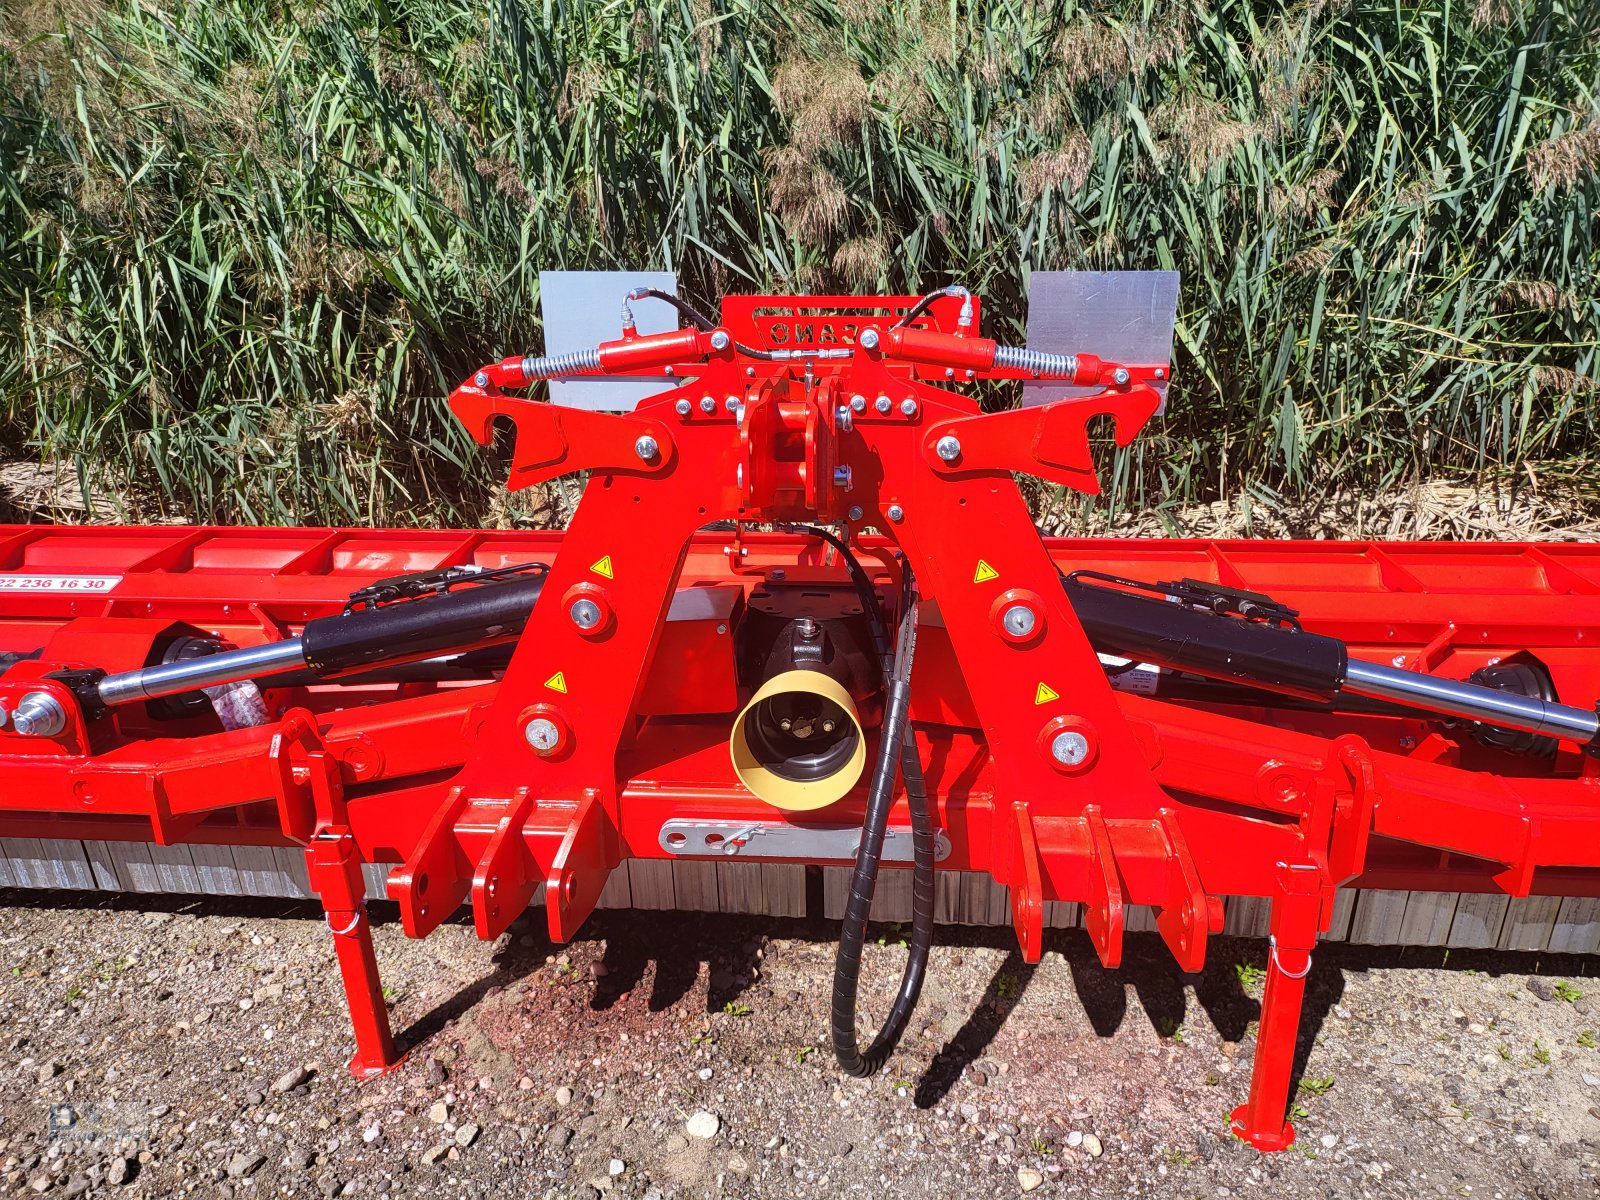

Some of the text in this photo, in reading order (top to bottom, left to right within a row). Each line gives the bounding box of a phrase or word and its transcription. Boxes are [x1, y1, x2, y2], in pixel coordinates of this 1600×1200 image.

[19, 579, 53, 588] 236
[59, 579, 79, 589] 16
[83, 580, 106, 589] 30
